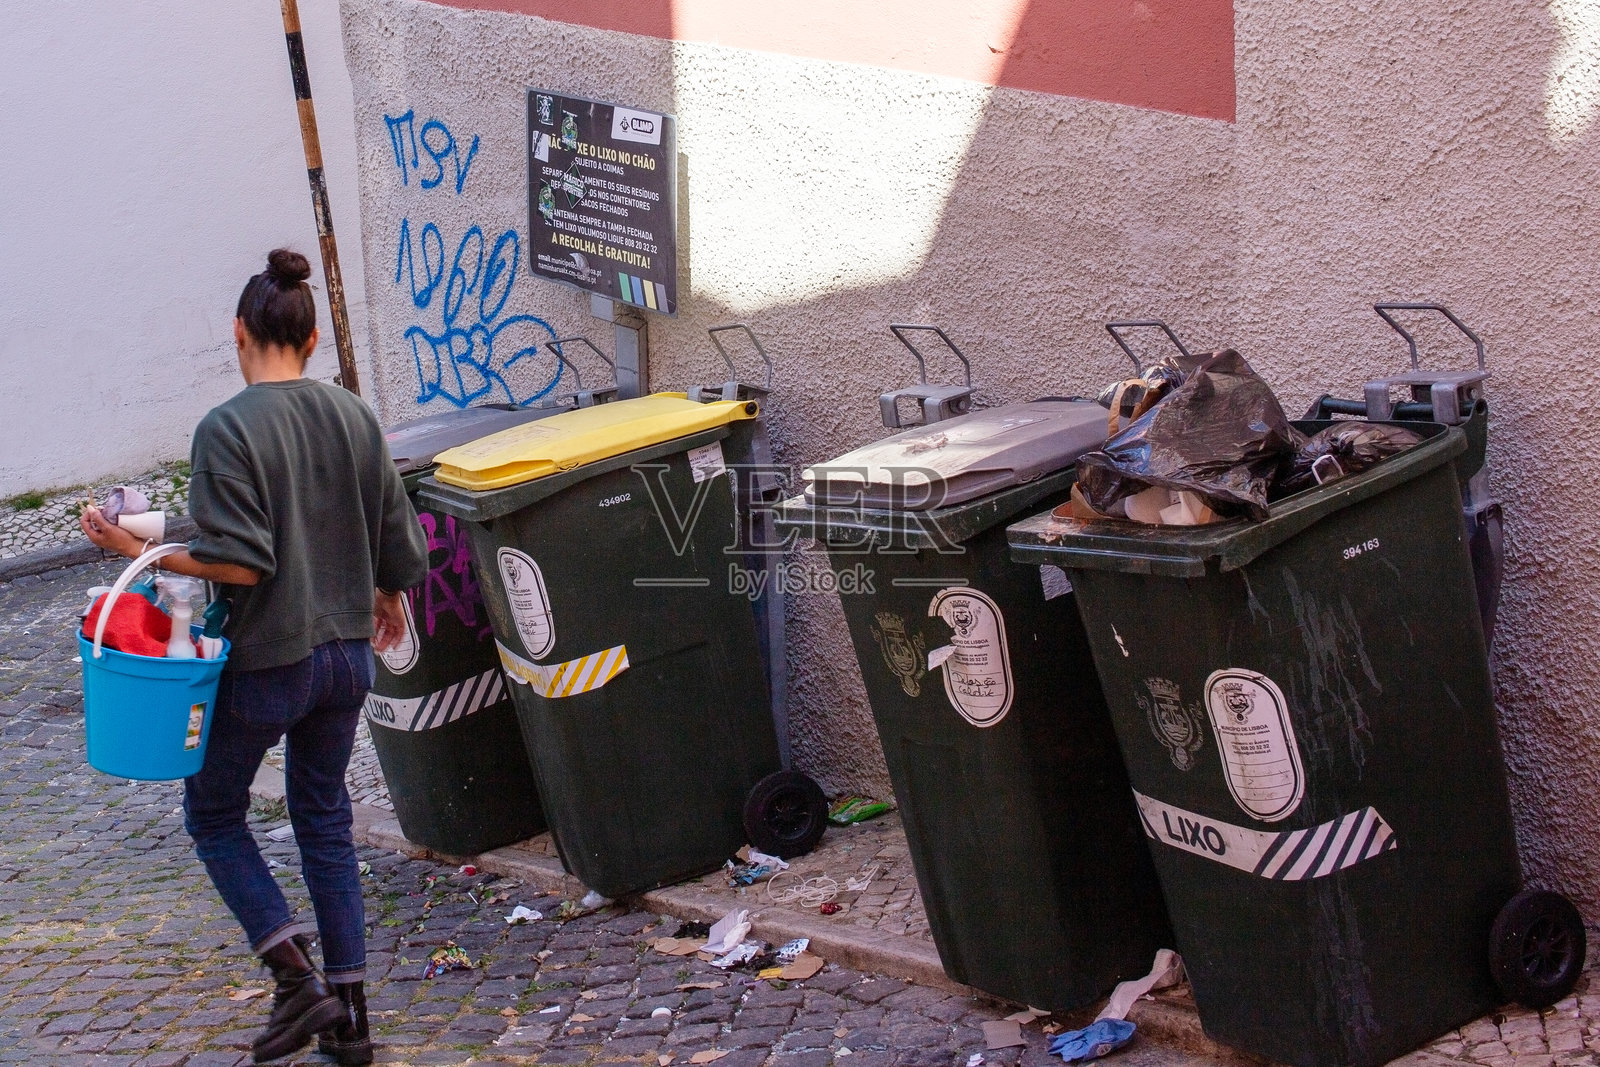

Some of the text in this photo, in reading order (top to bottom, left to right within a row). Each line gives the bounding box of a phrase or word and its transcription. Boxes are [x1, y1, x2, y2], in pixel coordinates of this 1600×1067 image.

[574, 157, 624, 176] SUJEITO A COIMAS
[590, 144, 596, 156] O
[597, 146, 617, 162] LIXO
[618, 150, 630, 165] NO
[632, 153, 656, 170] CHÃO
[598, 190, 610, 201] NOS
[610, 194, 650, 211] CONTENTORES
[608, 182, 616, 191] OS
[616, 183, 630, 195] SEUS
[632, 186, 660, 202] RESÍDUOS
[600, 202, 628, 217] FECHADOS
[553, 219, 564, 230] TEM
[564, 222, 577, 232] LIXO
[578, 226, 606, 240] VOLUMOSO
[608, 233, 624, 246] LIGUE
[624, 238, 634, 248] 808
[635, 240, 642, 250] 20
[642, 242, 650, 252] 32
[650, 244, 658, 254] 32
[579, 214, 602, 228] SEMPRE
[602, 220, 607, 230] A
[607, 222, 626, 235] TAMPA
[627, 226, 654, 242] FECHADA
[552, 232, 650, 270] A RECOLHA É GRATUITA!
[598, 492, 632, 508] 434902
[368, 696, 396, 724] LIXO
[1162, 810, 1226, 856] LIXO
